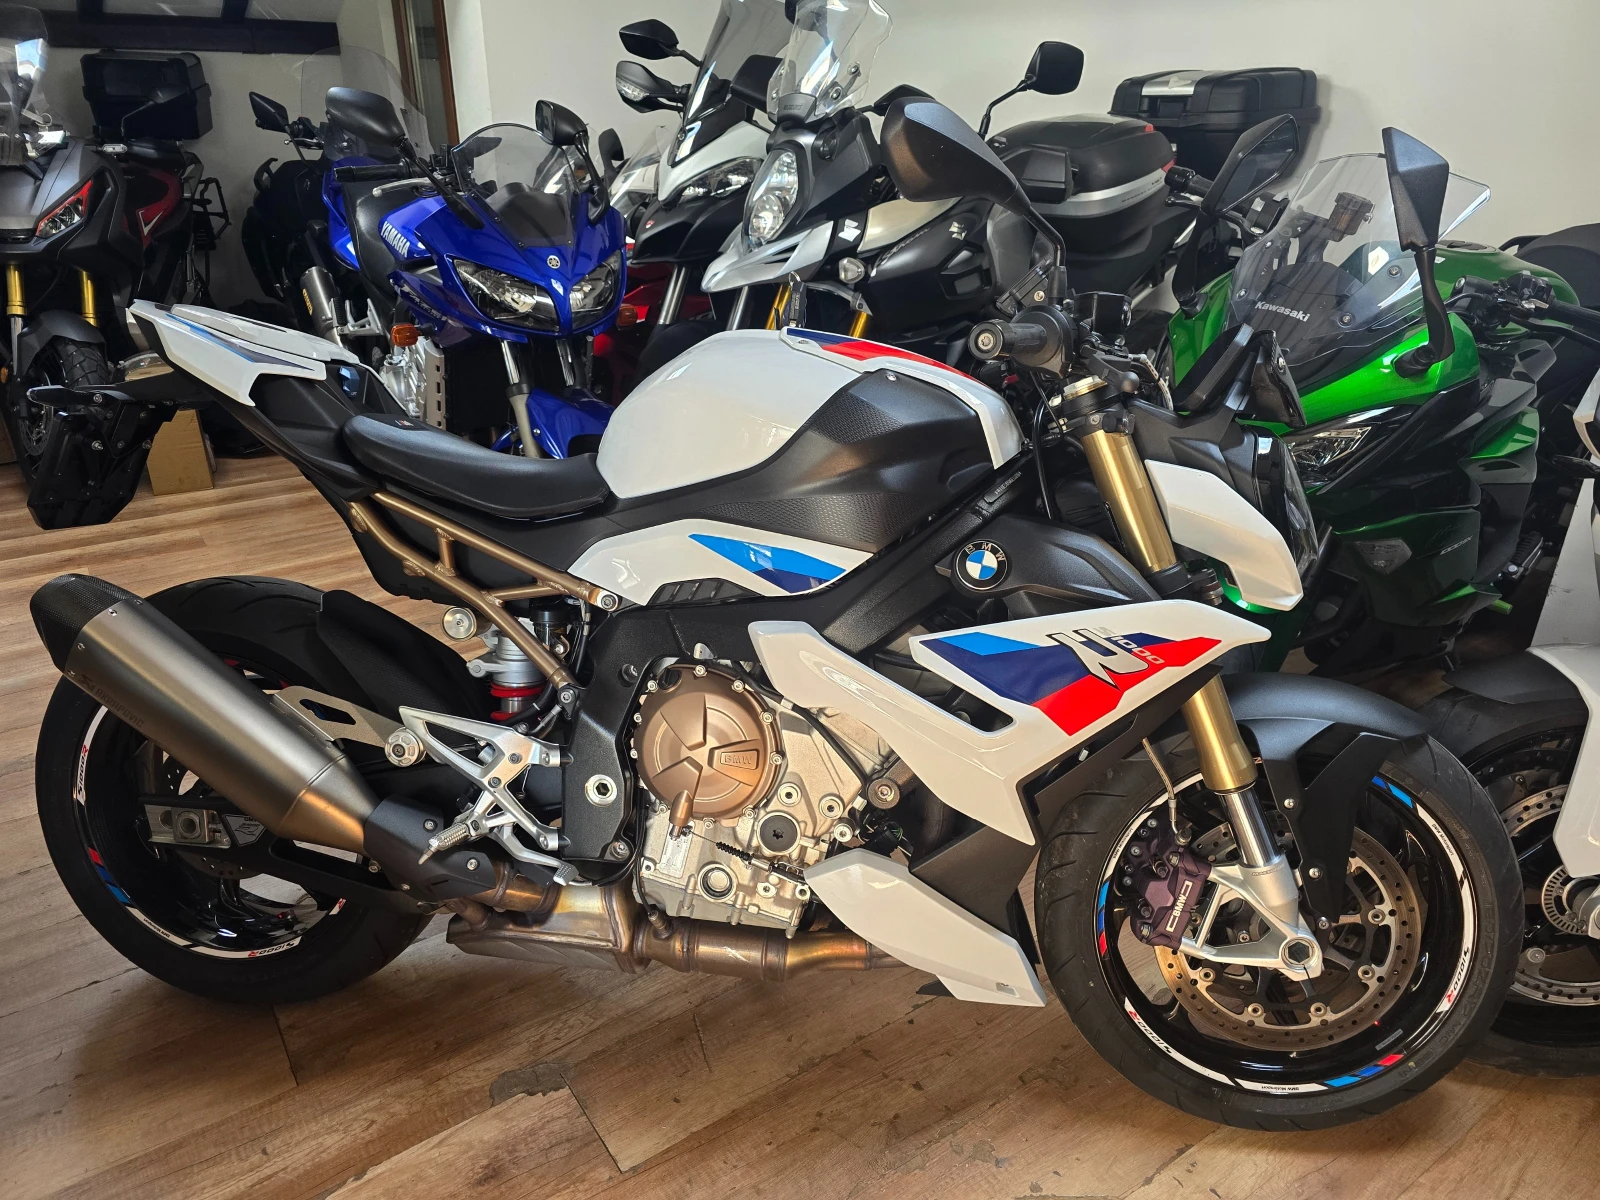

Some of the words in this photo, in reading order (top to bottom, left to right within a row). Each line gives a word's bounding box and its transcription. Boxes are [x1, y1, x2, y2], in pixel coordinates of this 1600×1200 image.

[380, 220, 411, 259] YAMAHA
[1254, 300, 1311, 323] Kawasaki
[964, 542, 1006, 562] BMW
[724, 754, 753, 765] BMW
[1172, 893, 1188, 917] BMW
[247, 941, 295, 958] S1000R
[1445, 946, 1470, 1005] S1000R
[1128, 1010, 1172, 1054] S1000R
